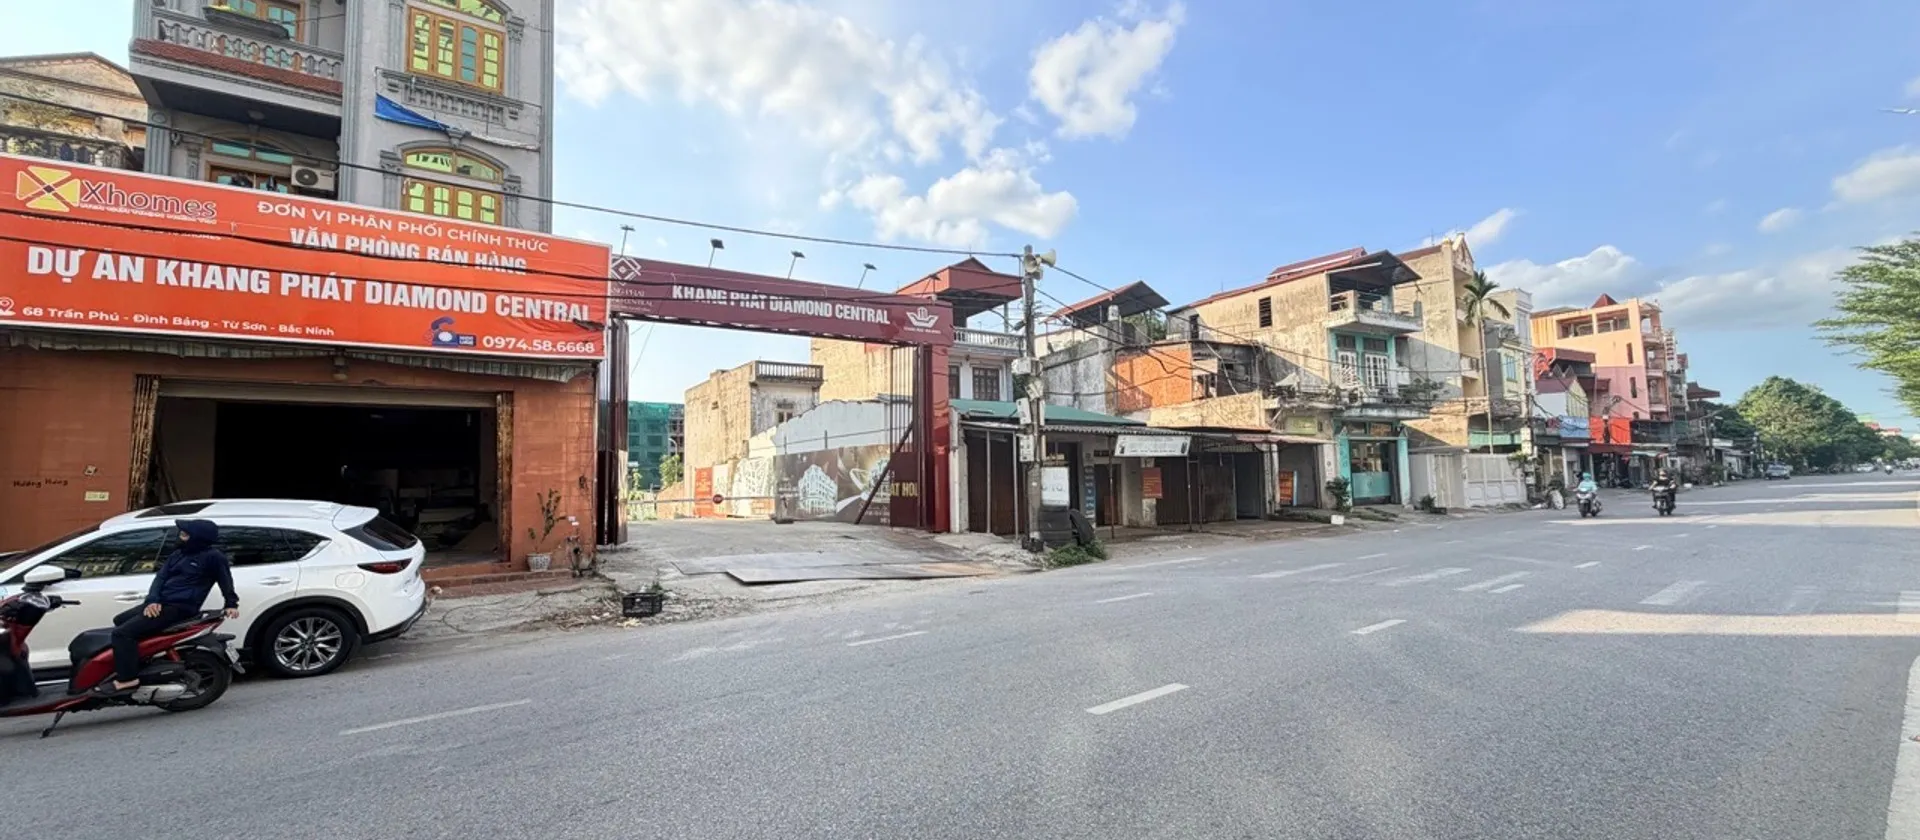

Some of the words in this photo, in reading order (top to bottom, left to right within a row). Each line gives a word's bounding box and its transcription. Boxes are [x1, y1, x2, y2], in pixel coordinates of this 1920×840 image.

[82, 180, 218, 219] Xhomes
[257, 202, 306, 219] ĐƠN
[312, 208, 332, 225] VỊ
[337, 212, 392, 231] PHÂN
[398, 221, 443, 238] PHỐI
[448, 228, 501, 246] CHÍNH
[505, 237, 549, 253] THỨC
[290, 226, 338, 249] VĂN
[345, 235, 420, 259] PHÒNG
[427, 245, 469, 268] BÁN
[475, 251, 527, 275] HÀNG
[27, 246, 87, 284] DỰ
[156, 258, 271, 294] KHANG
[280, 272, 357, 302] PHÁT
[364, 280, 488, 315] DIAMOND
[495, 294, 591, 322] CENTRAL
[22, 306, 44, 317] 68
[132, 313, 169, 325] Đình
[242, 321, 268, 332] Sơn
[305, 326, 335, 337] Ninh
[672, 285, 728, 306] KHANG
[769, 295, 834, 318] DIAMOND
[835, 305, 891, 325] CENTRAL
[482, 335, 596, 354] 0974.58.6668
